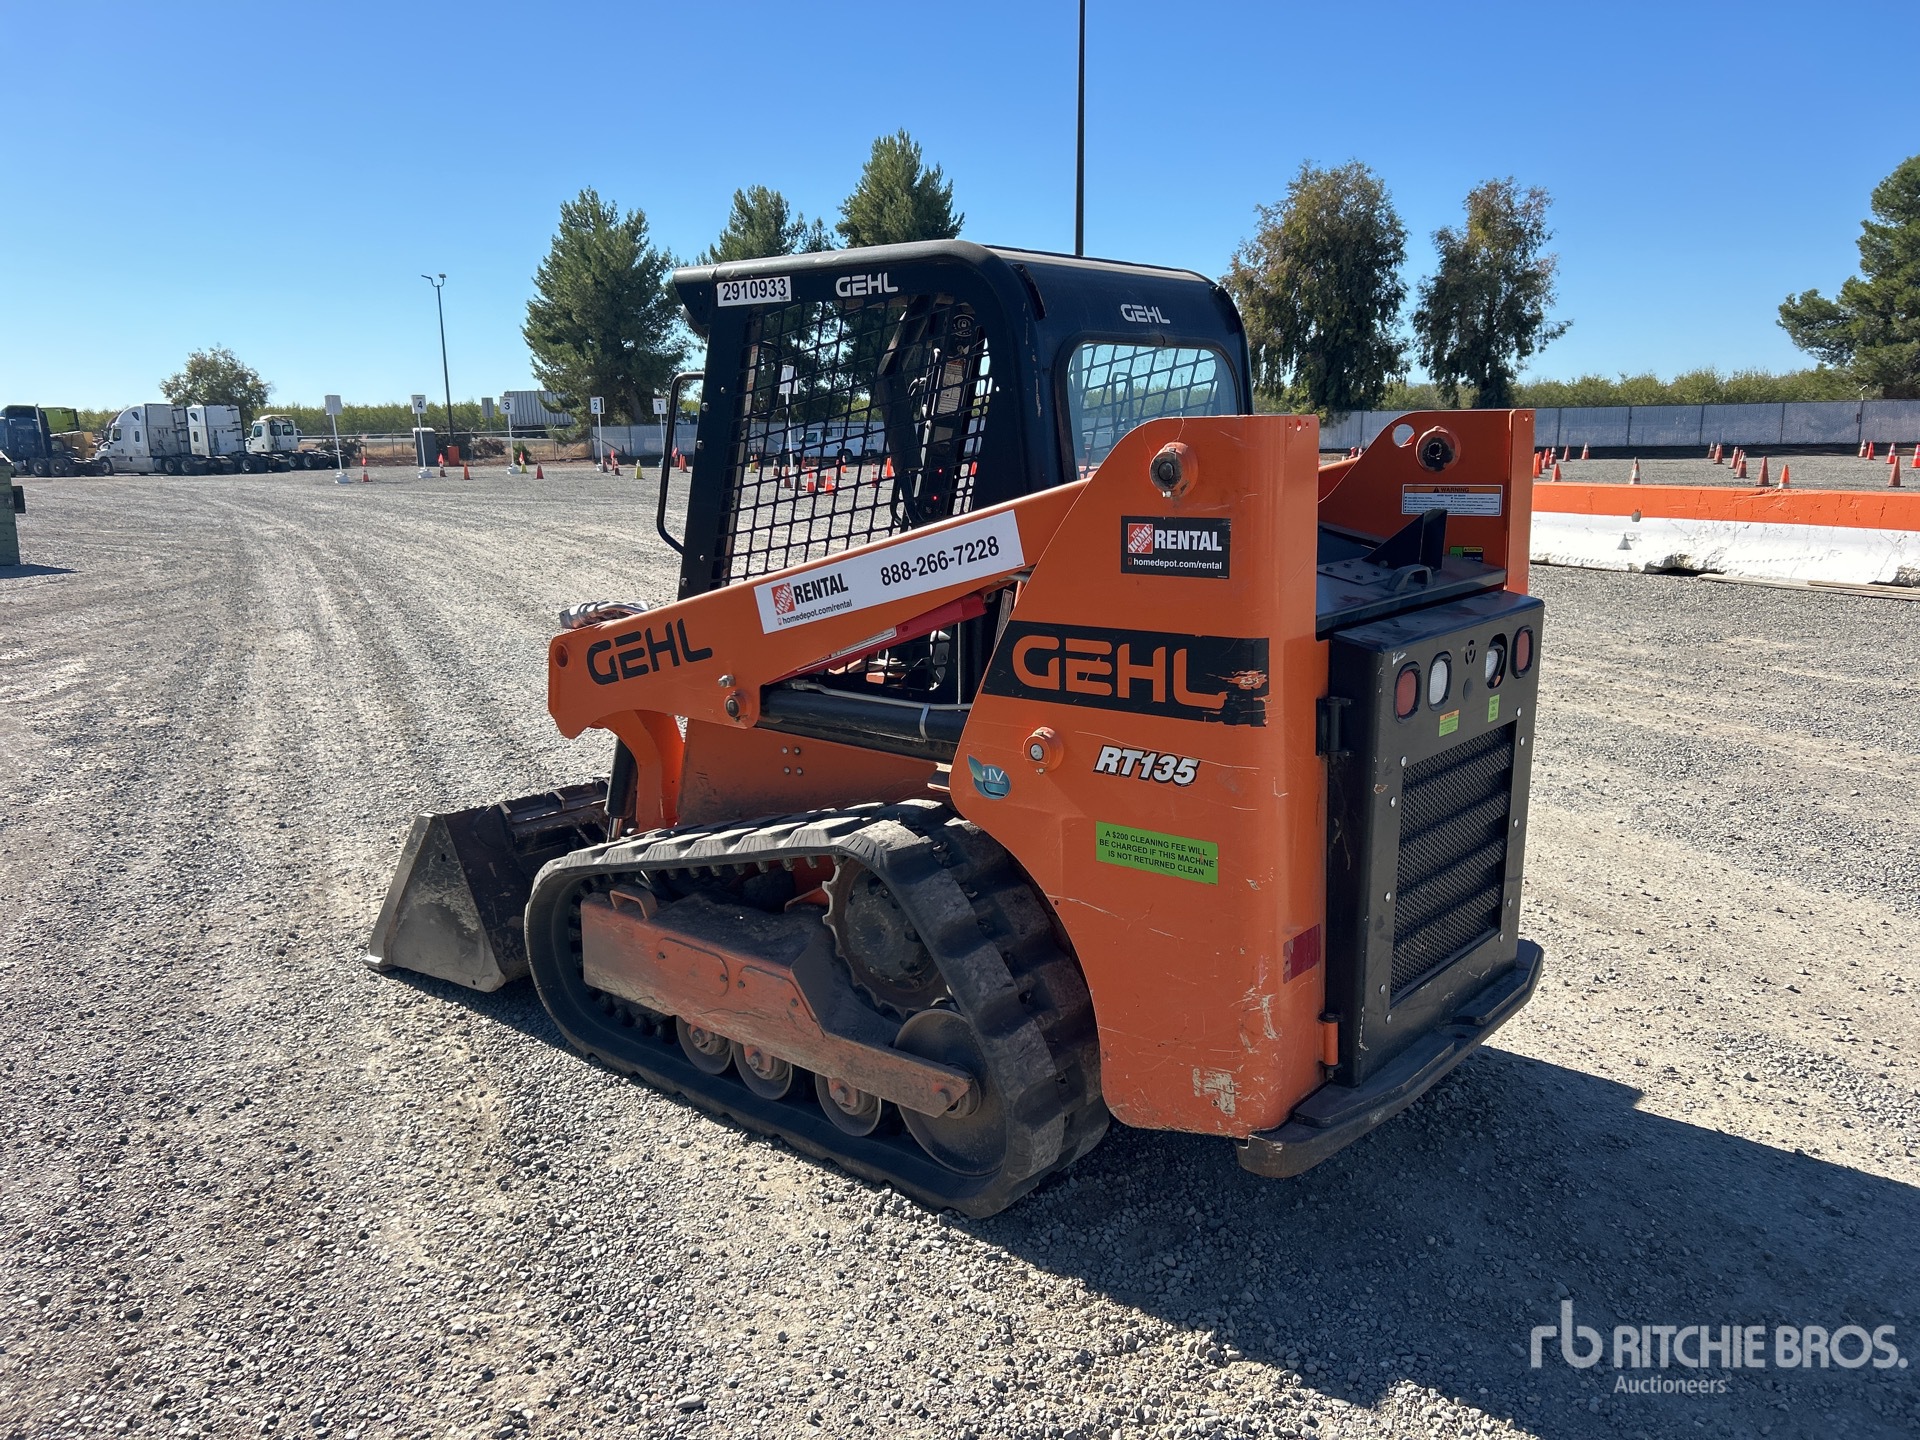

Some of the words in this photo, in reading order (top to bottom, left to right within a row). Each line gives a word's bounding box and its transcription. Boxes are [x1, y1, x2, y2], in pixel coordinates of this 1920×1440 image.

[722, 278, 787, 301] 2910933
[835, 272, 899, 297] GEHL
[1120, 303, 1171, 324] GEHL
[417, 401, 423, 410] 4
[504, 402, 511, 411] 3
[593, 402, 598, 410] 2
[1128, 523, 1153, 553] HOME
[1131, 526, 1141, 539] THE
[1137, 536, 1153, 553] DEPOT
[1154, 529, 1223, 552] RENTAL
[880, 535, 1000, 587] 888-266-7228
[1133, 557, 1222, 570] homedepot.com/rental
[792, 572, 849, 605] RENTAL
[781, 599, 853, 625] homedepot.com/rental
[586, 618, 713, 686] GEHL
[1012, 634, 1228, 710] GEHL
[1093, 744, 1200, 787] RT135
[1099, 838, 1109, 847] BE
[1110, 840, 1148, 855] CHARGED
[1149, 848, 1157, 856] IF
[1158, 849, 1176, 860] THIS
[1105, 830, 1111, 838] A
[1112, 831, 1129, 841] $200
[1130, 834, 1169, 849] CLEANING
[1171, 842, 1186, 852] FEE
[1187, 845, 1208, 856] WILL
[1108, 850, 1115, 858] IS
[1116, 851, 1132, 860] NOT
[1134, 855, 1176, 870] RETURNED
[1177, 864, 1205, 876] CLEAN
